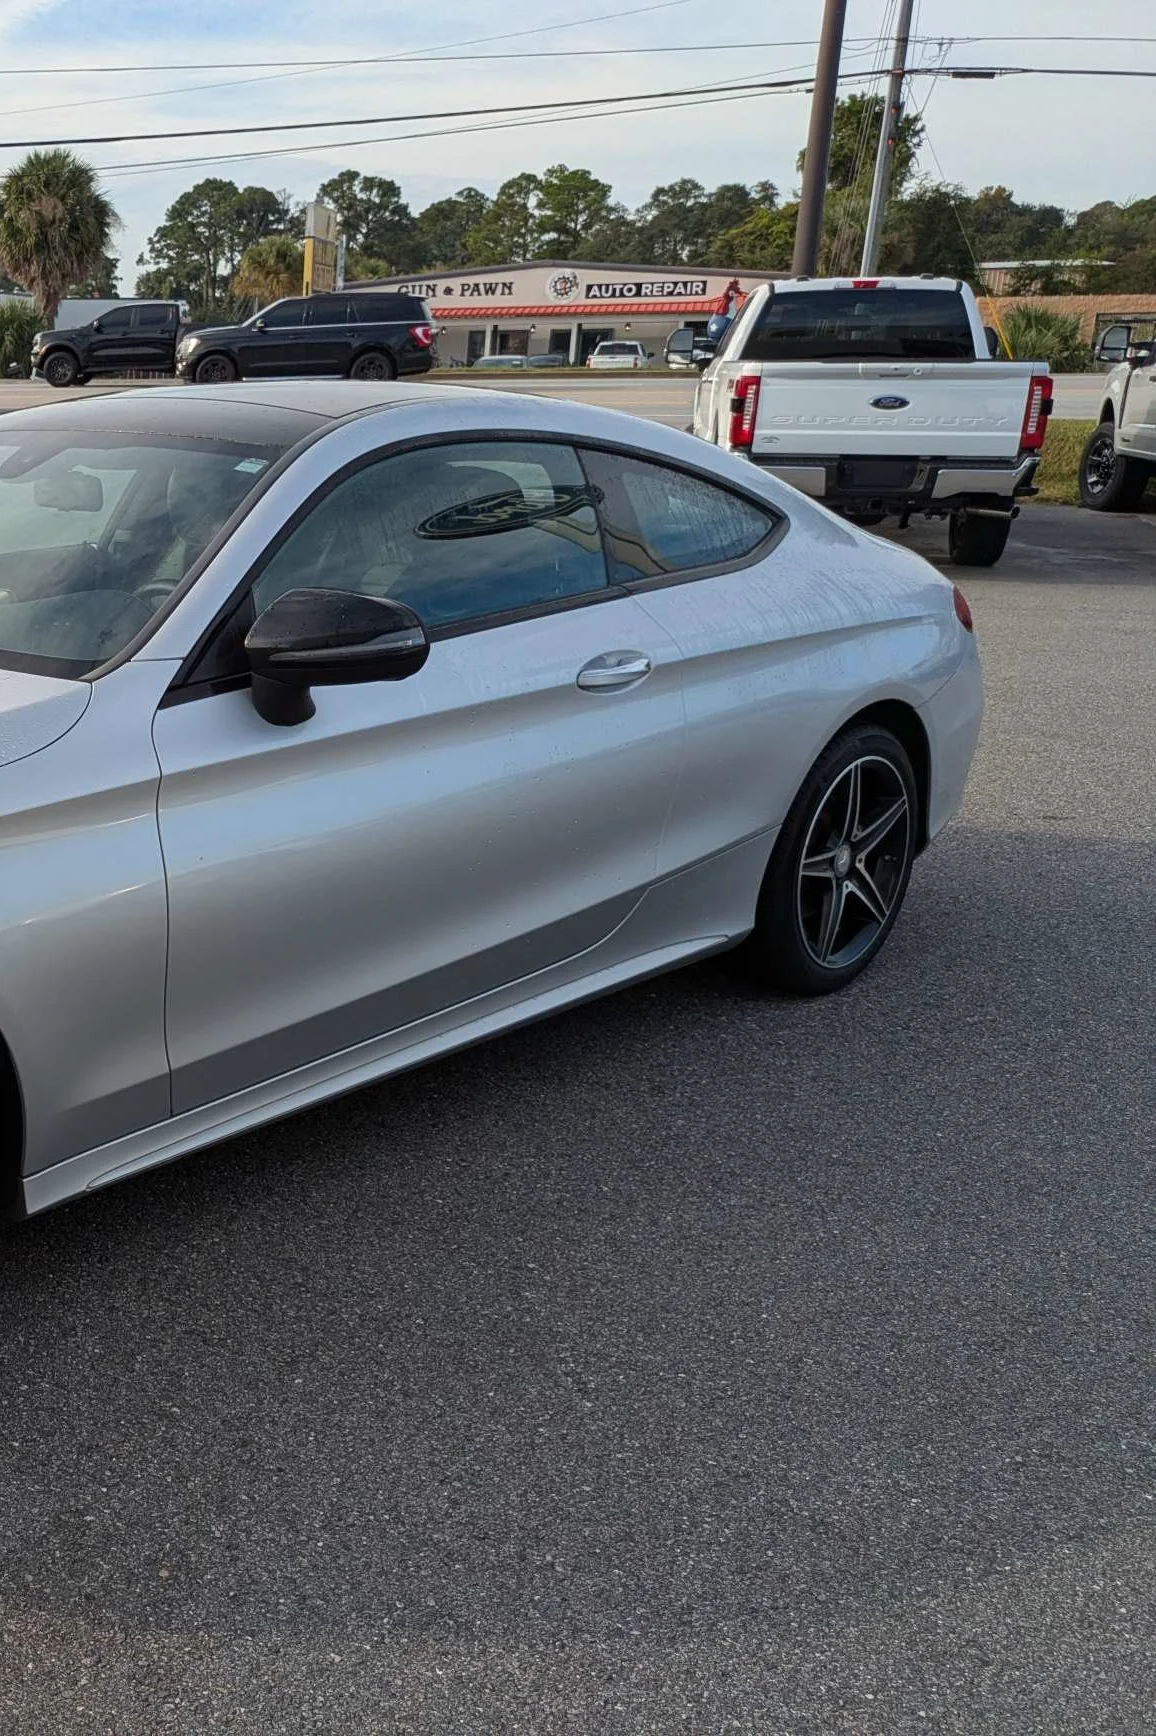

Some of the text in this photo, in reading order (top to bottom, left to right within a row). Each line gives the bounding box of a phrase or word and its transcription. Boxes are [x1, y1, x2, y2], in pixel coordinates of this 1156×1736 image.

[398, 282, 514, 297] GUN & PAWN
[588, 281, 705, 298] AUTO REPAIR
[770, 415, 1011, 426] SUPER DUTY
